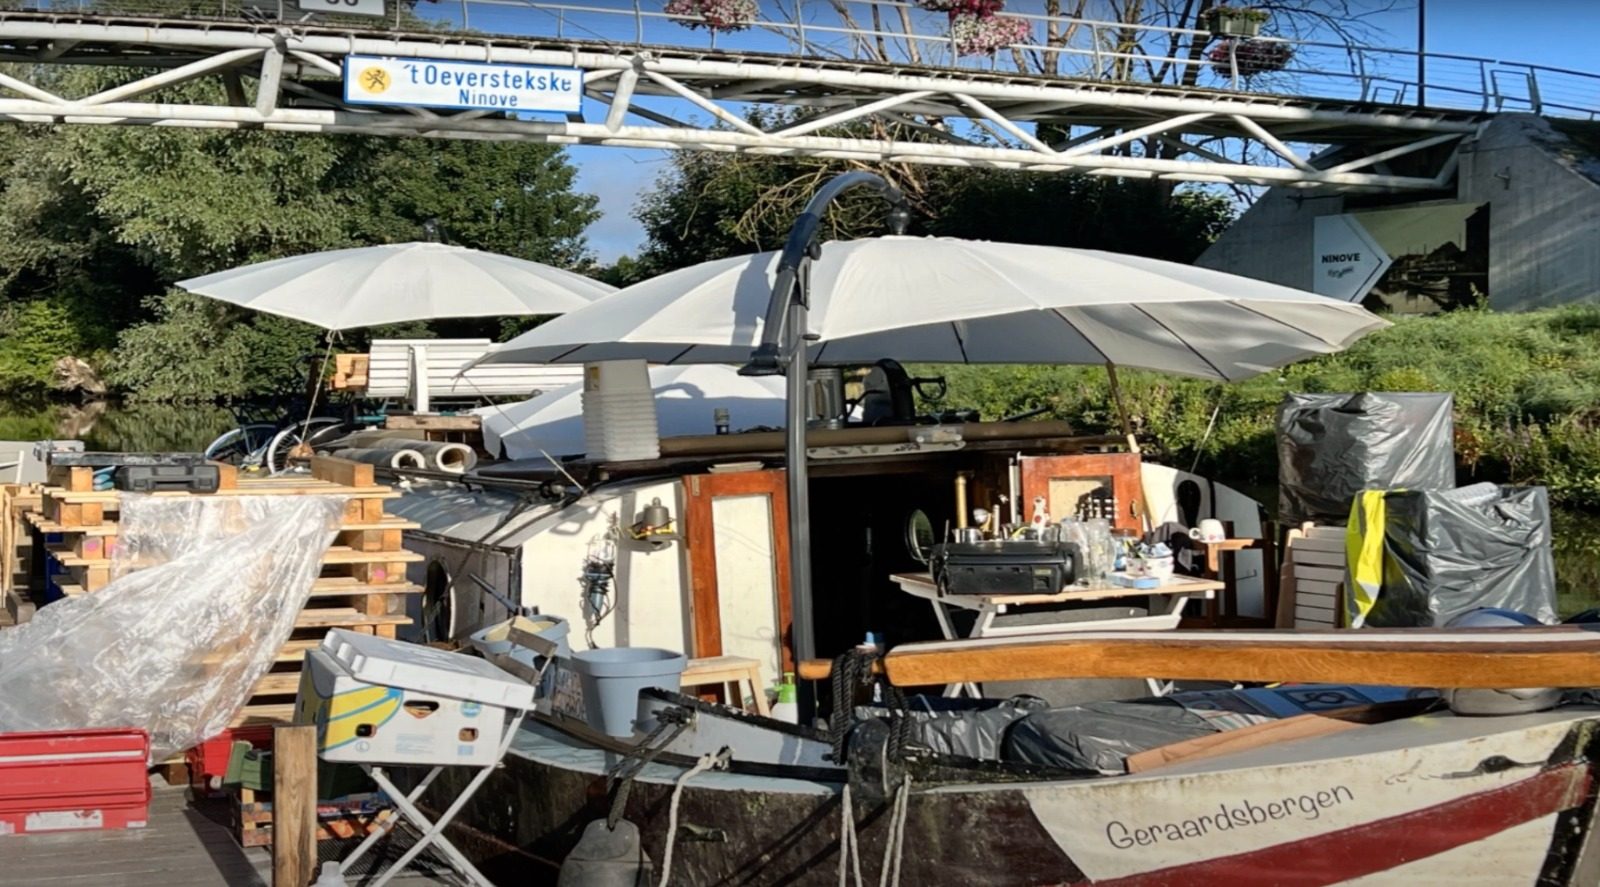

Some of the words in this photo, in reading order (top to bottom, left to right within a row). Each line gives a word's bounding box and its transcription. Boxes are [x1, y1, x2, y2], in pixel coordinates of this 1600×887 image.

[424, 64, 572, 91] Oeverstekske
[459, 88, 519, 107] Ninove
[1321, 252, 1361, 264] NINOVE
[1106, 784, 1355, 849] Geraardsbergen
